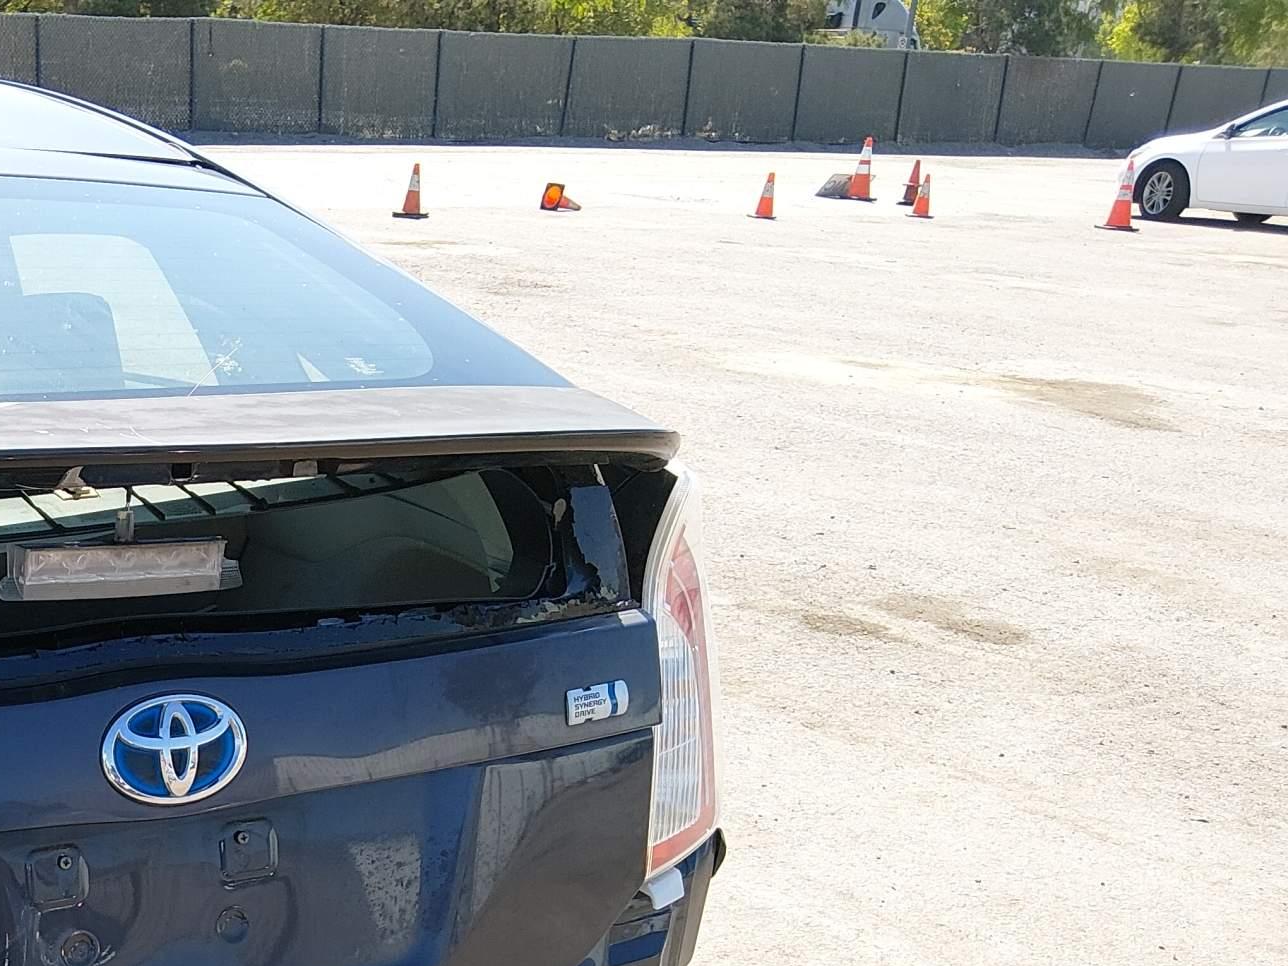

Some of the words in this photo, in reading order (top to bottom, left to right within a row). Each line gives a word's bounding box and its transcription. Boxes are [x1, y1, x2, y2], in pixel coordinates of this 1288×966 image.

[573, 691, 601, 703] HYBRID
[574, 698, 608, 711] SYNERGY
[574, 709, 596, 718] DRIVE
